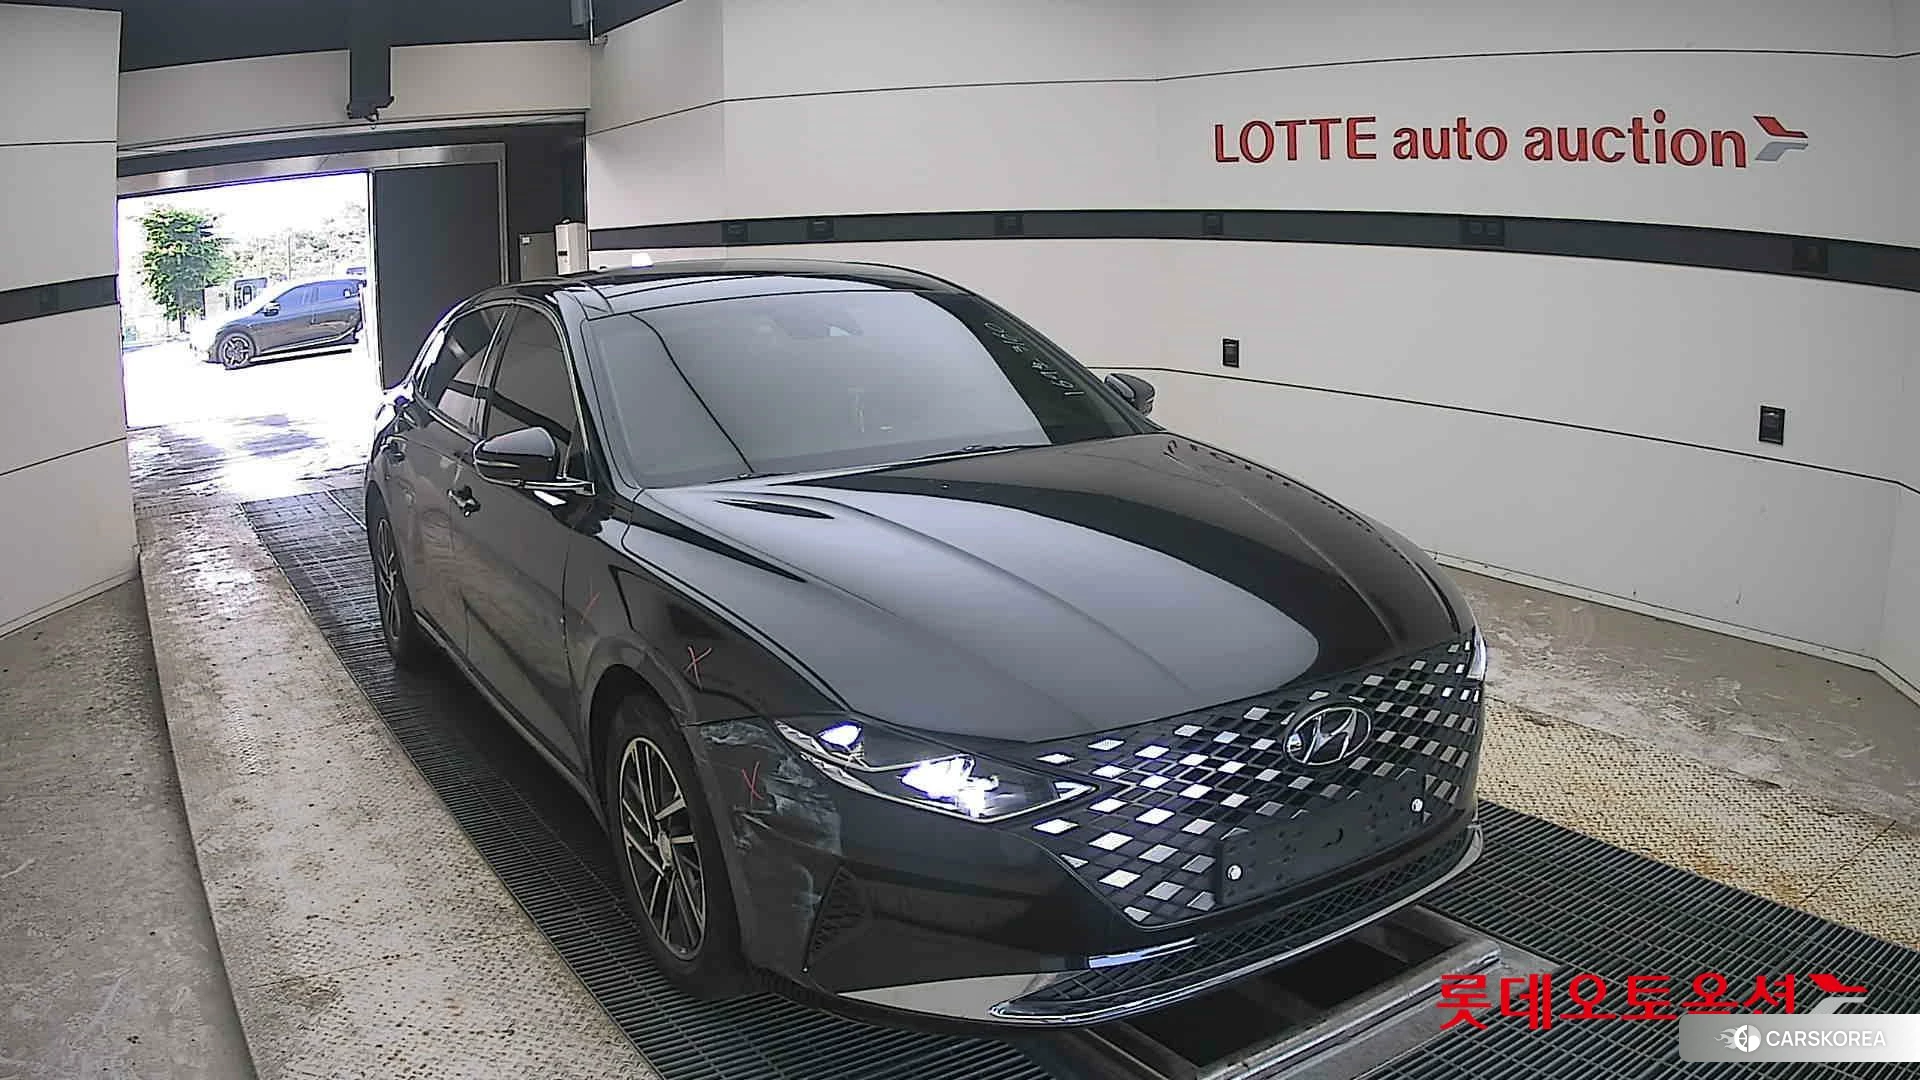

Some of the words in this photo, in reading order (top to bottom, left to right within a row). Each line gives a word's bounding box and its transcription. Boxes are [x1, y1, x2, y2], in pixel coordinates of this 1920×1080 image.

[1214, 116, 1376, 163] LOTTE
[1392, 116, 1508, 161] auto
[1523, 108, 1747, 168] auction
